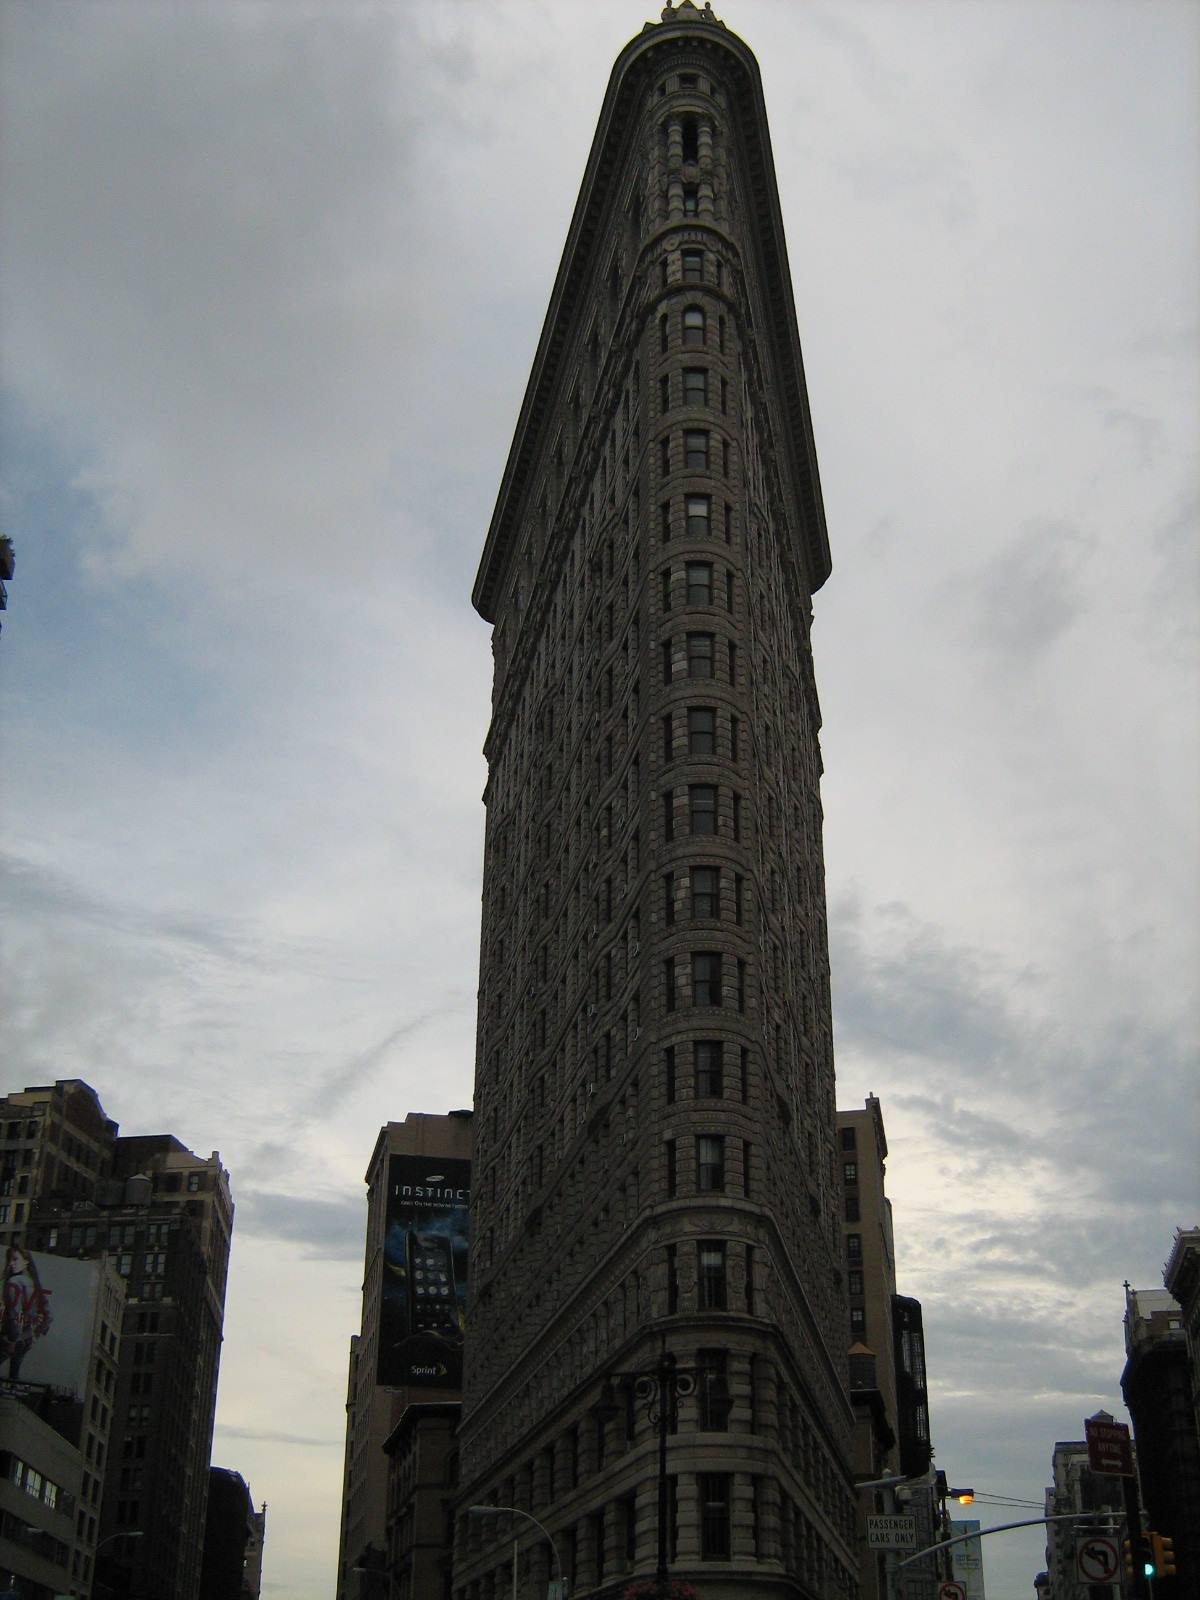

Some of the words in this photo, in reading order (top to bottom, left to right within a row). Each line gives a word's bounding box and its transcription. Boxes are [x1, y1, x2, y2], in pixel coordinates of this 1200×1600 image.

[411, 1364, 436, 1375] Sprint
[869, 1519, 913, 1529] PASSENGER
[870, 1532, 889, 1543] CARS
[895, 1532, 914, 1543] ONLY
